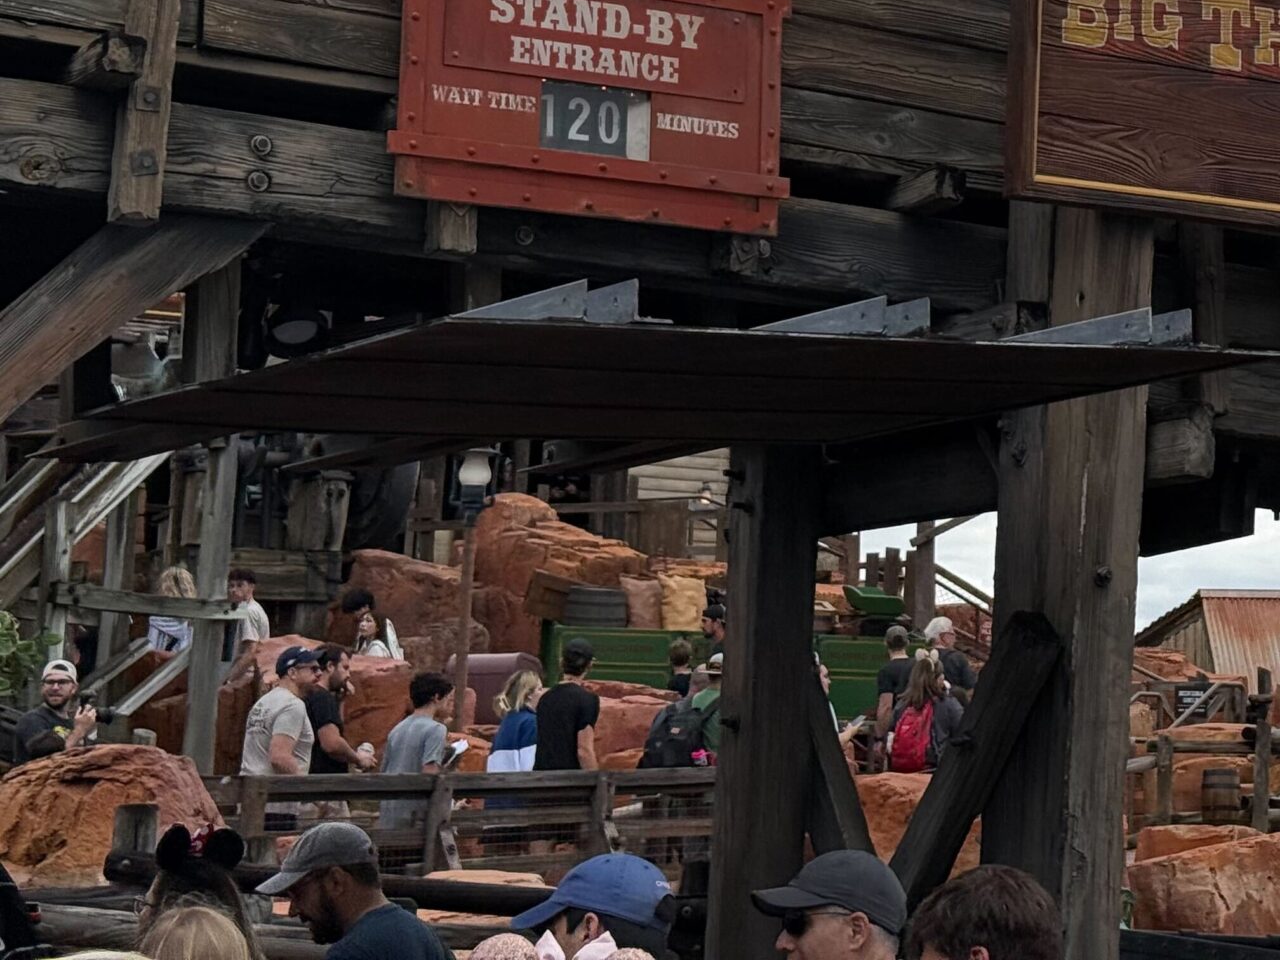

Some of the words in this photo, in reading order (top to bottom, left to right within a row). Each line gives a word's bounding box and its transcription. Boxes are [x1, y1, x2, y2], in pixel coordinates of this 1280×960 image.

[509, 35, 680, 84] ENTRANCE
[432, 84, 483, 107] WAIT
[487, 90, 537, 113] TIME
[541, 92, 622, 145] 120
[656, 112, 740, 140] MINUTES
